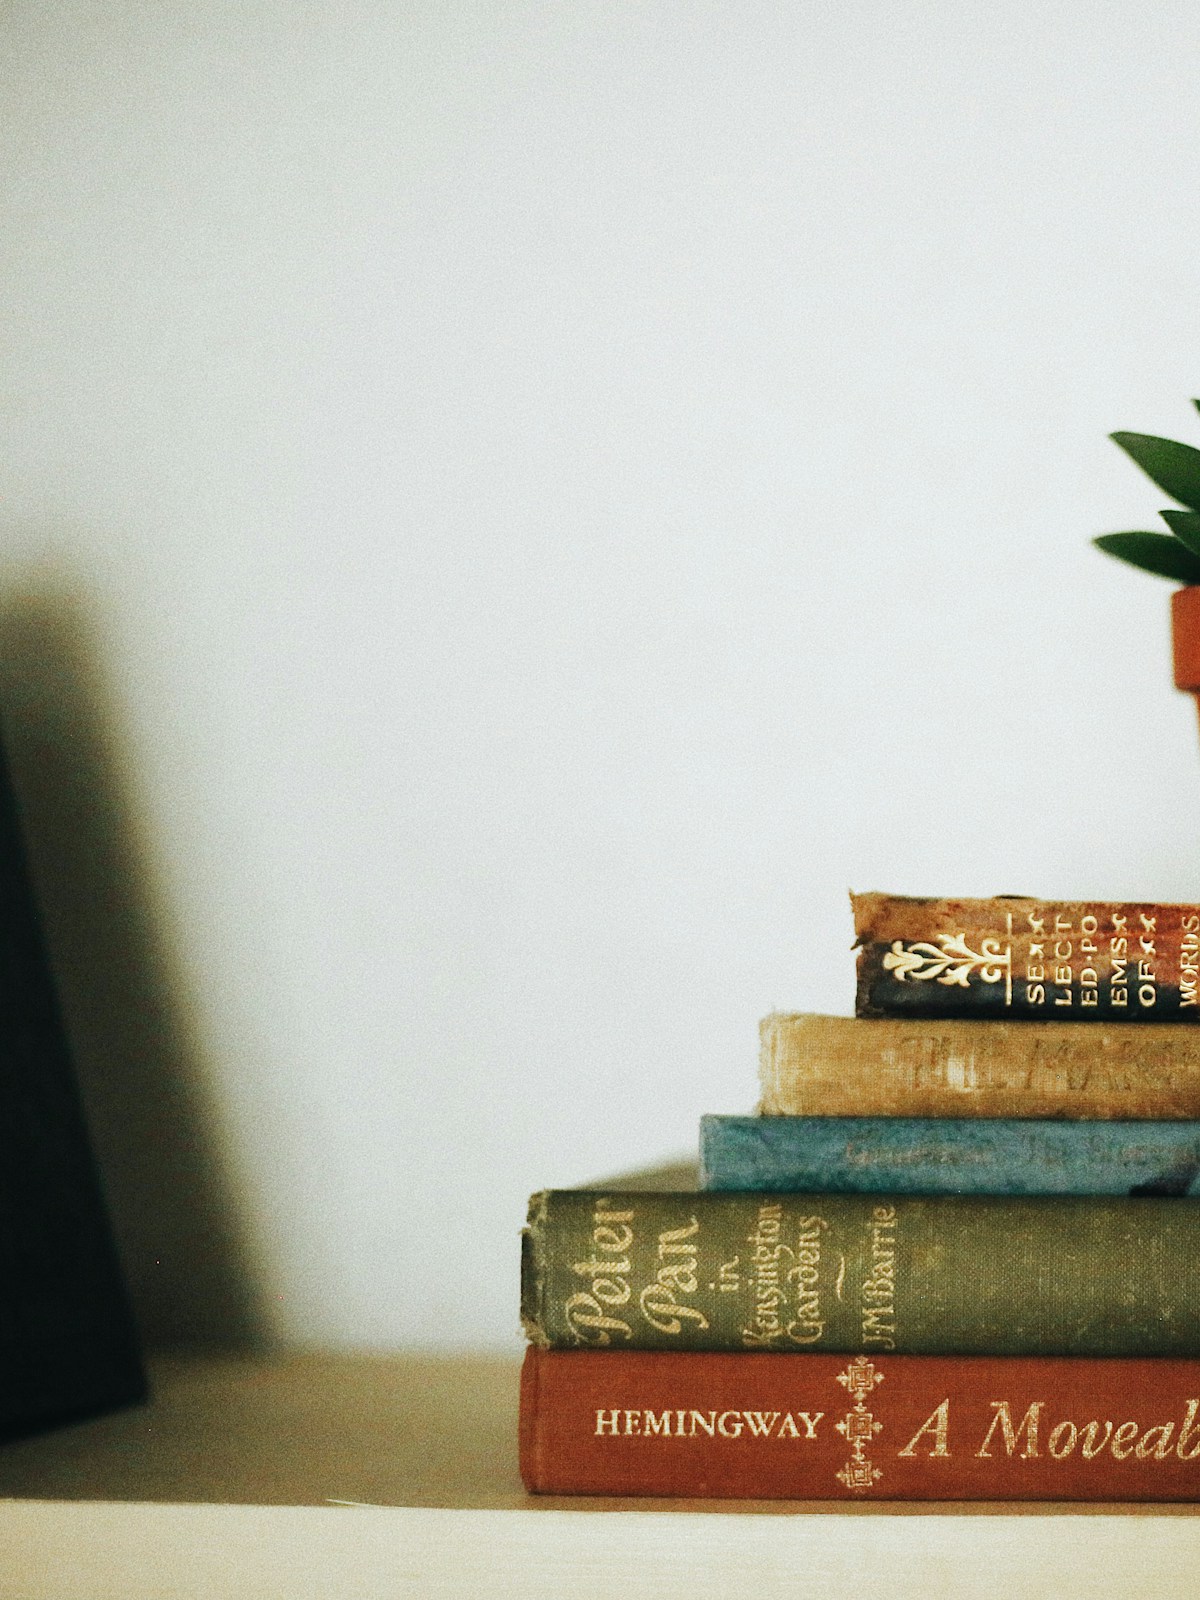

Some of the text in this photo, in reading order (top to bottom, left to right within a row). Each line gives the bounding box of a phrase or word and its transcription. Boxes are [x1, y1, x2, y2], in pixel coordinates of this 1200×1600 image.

[1055, 914, 1073, 1006] LECT
[1138, 959, 1157, 1007] OF
[1179, 915, 1200, 1008] WORDS
[565, 1199, 634, 1346] Peter
[640, 1216, 710, 1334] Pan
[709, 1255, 740, 1293] in
[742, 1202, 796, 1346] Kensington
[786, 1215, 828, 1345] Gardens
[594, 1409, 826, 1439] HEMINGWAY
[897, 1398, 952, 1458] A
